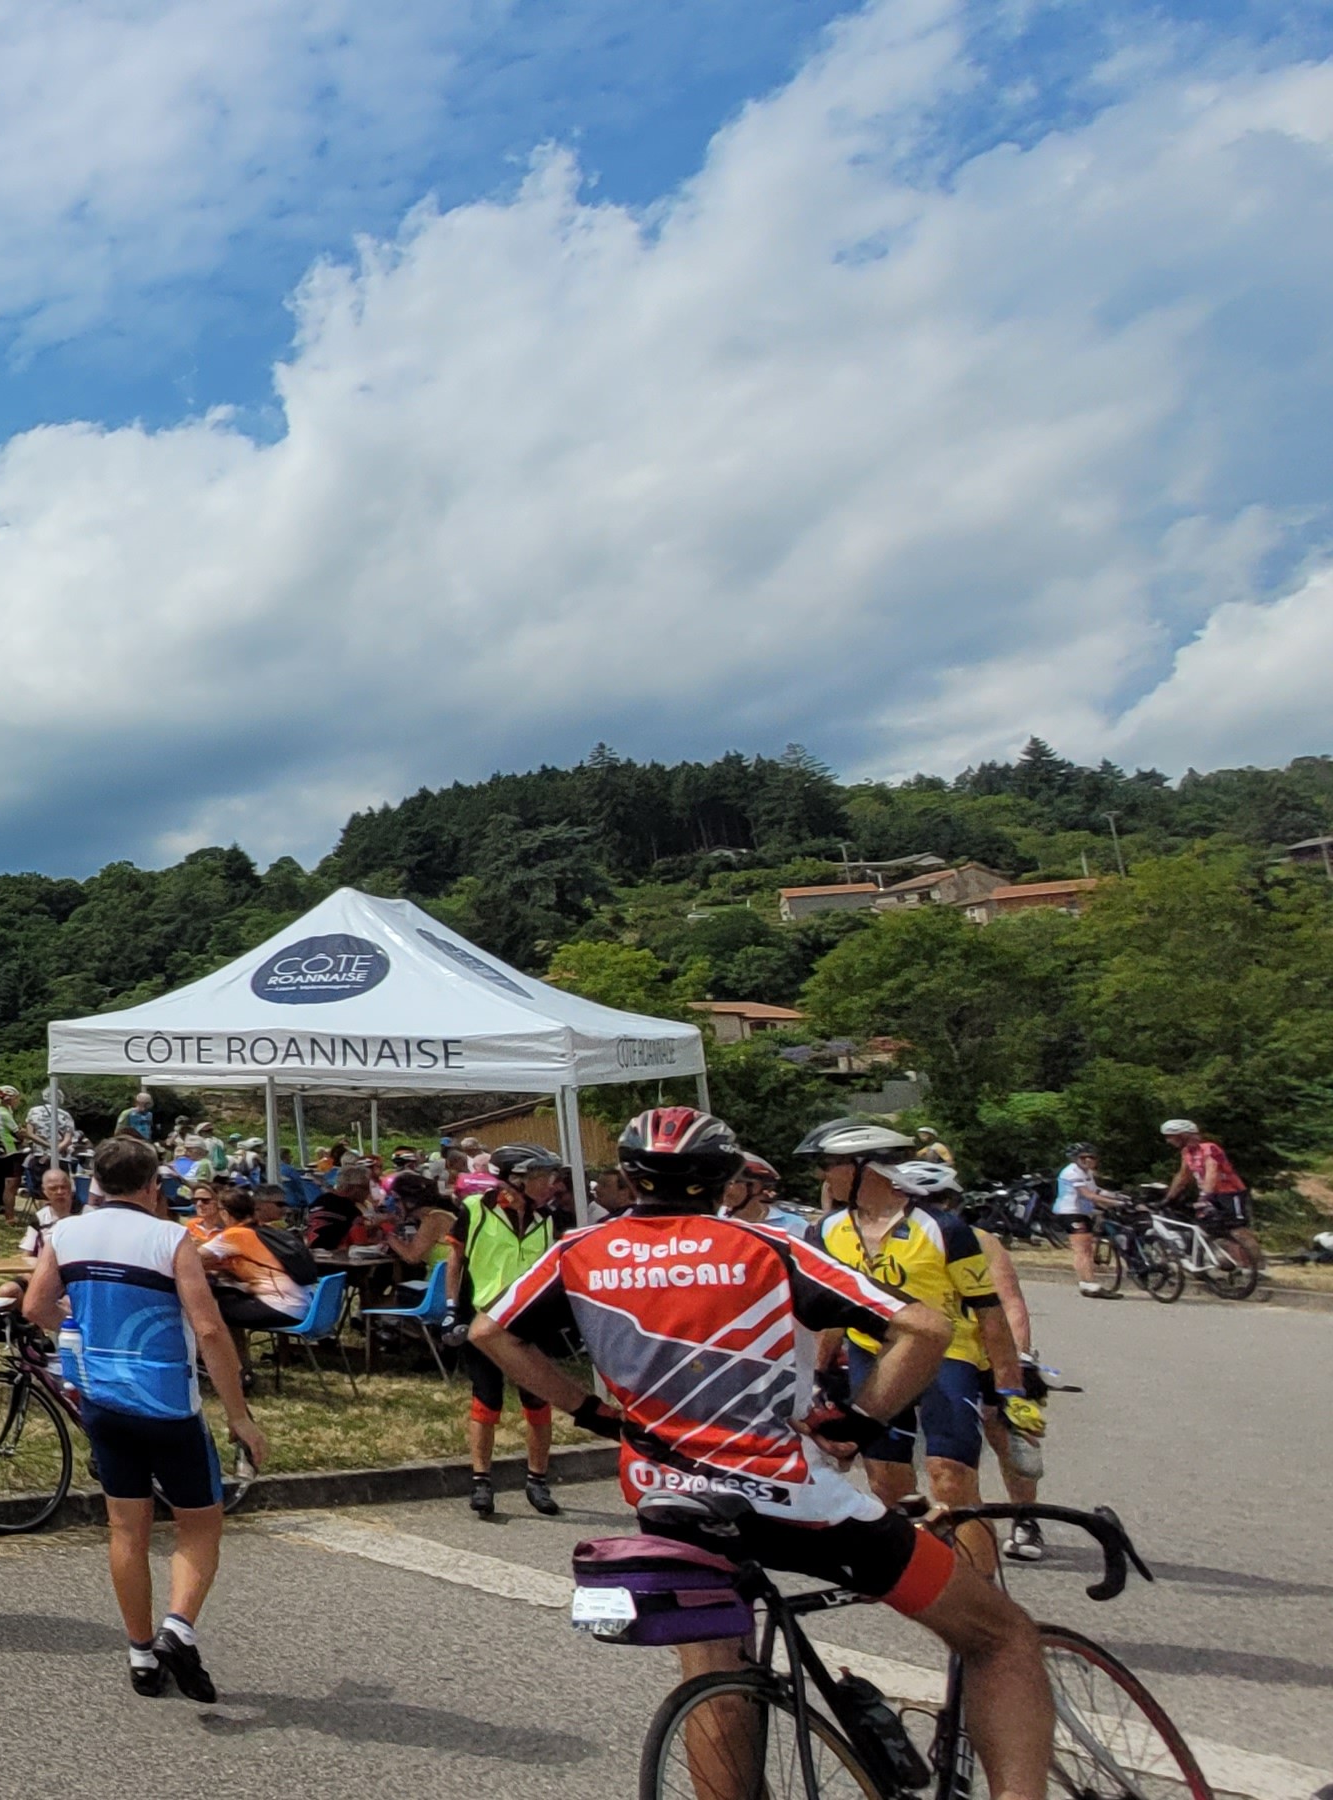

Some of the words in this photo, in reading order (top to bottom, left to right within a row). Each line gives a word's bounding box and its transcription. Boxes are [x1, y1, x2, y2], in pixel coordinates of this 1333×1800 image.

[273, 953, 374, 975] CÔTE
[266, 973, 368, 986] ROANNAISE
[123, 1031, 214, 1064] CÔTE
[226, 1036, 466, 1069] ROANNAISE
[607, 1237, 712, 1263] Cyclos
[589, 1263, 746, 1291] BUSSACAIS
[664, 1472, 774, 1500] express
